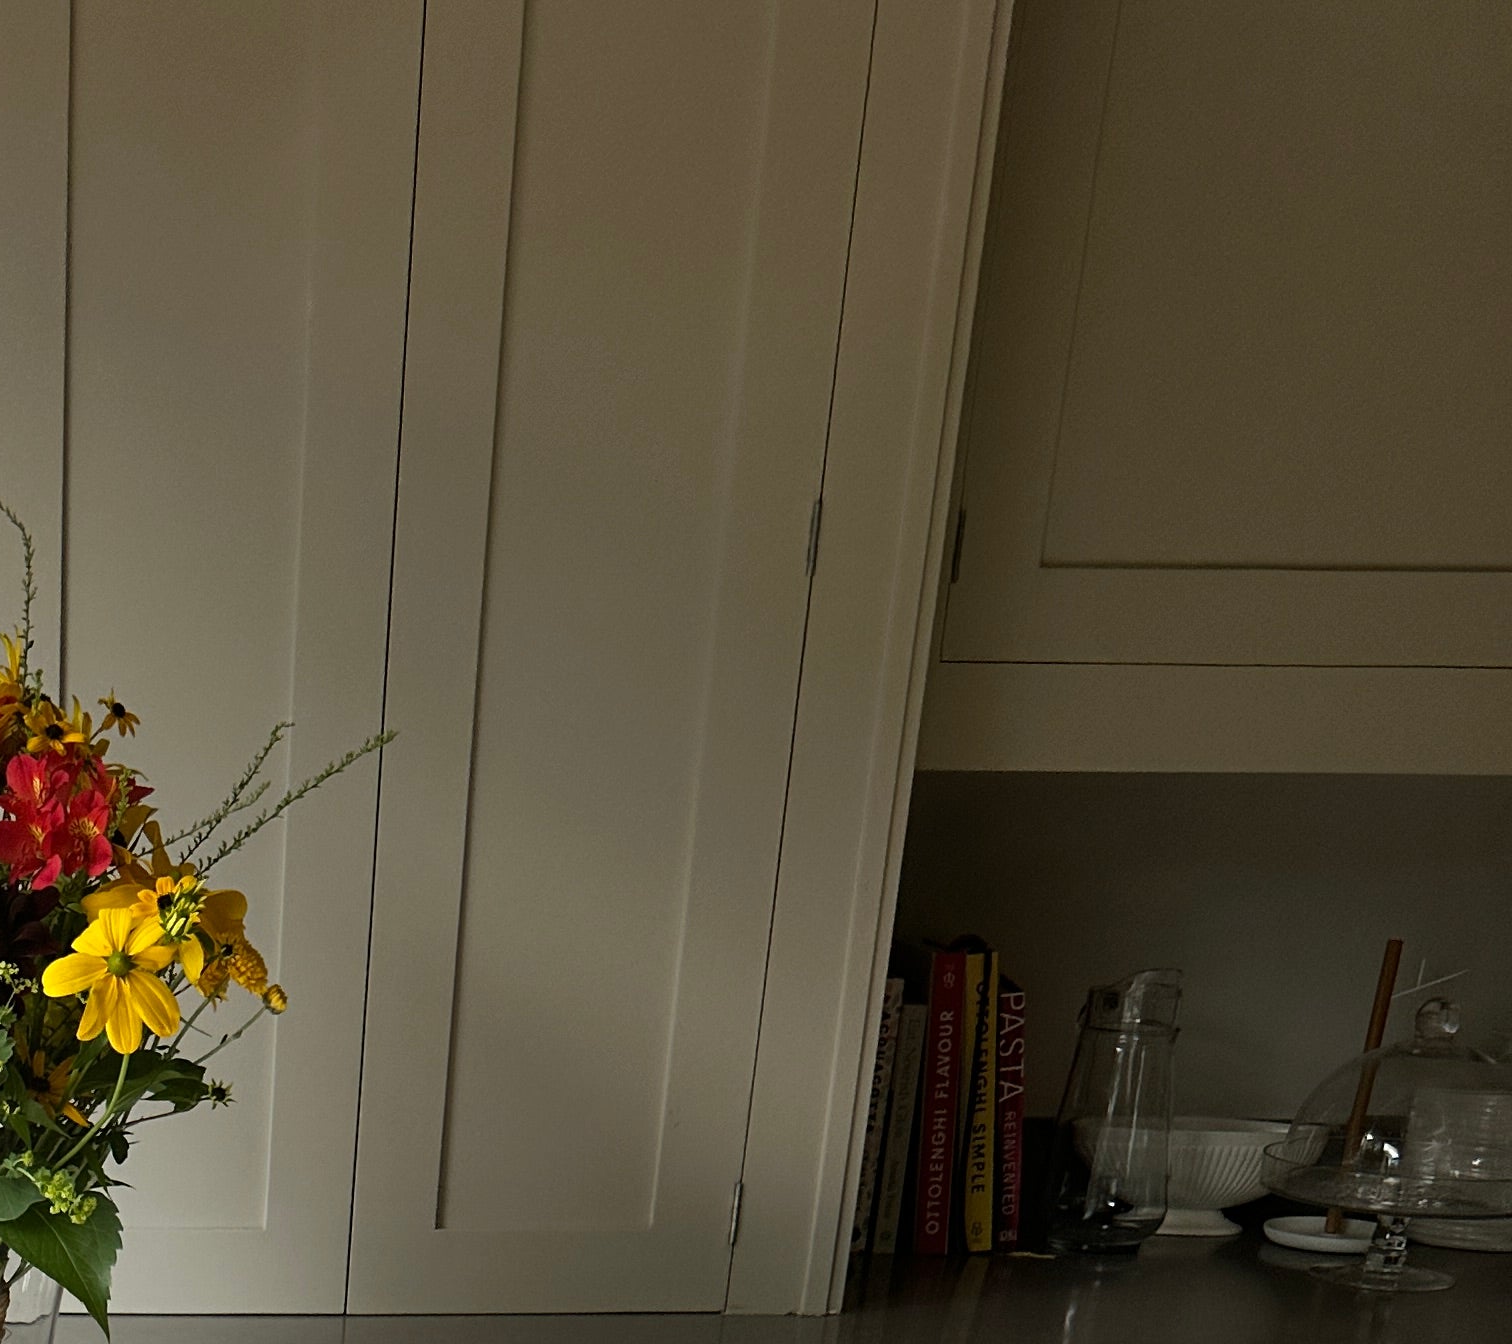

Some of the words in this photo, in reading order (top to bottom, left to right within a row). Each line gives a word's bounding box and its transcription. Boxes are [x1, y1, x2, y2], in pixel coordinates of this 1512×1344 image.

[935, 1010, 956, 1100] FLAVOUR
[999, 991, 1026, 1104] PASTA
[924, 1107, 947, 1235] OTTOLENGHI
[971, 1125, 987, 1194] SIMPLE
[1001, 1111, 1018, 1216] REINVENTED
